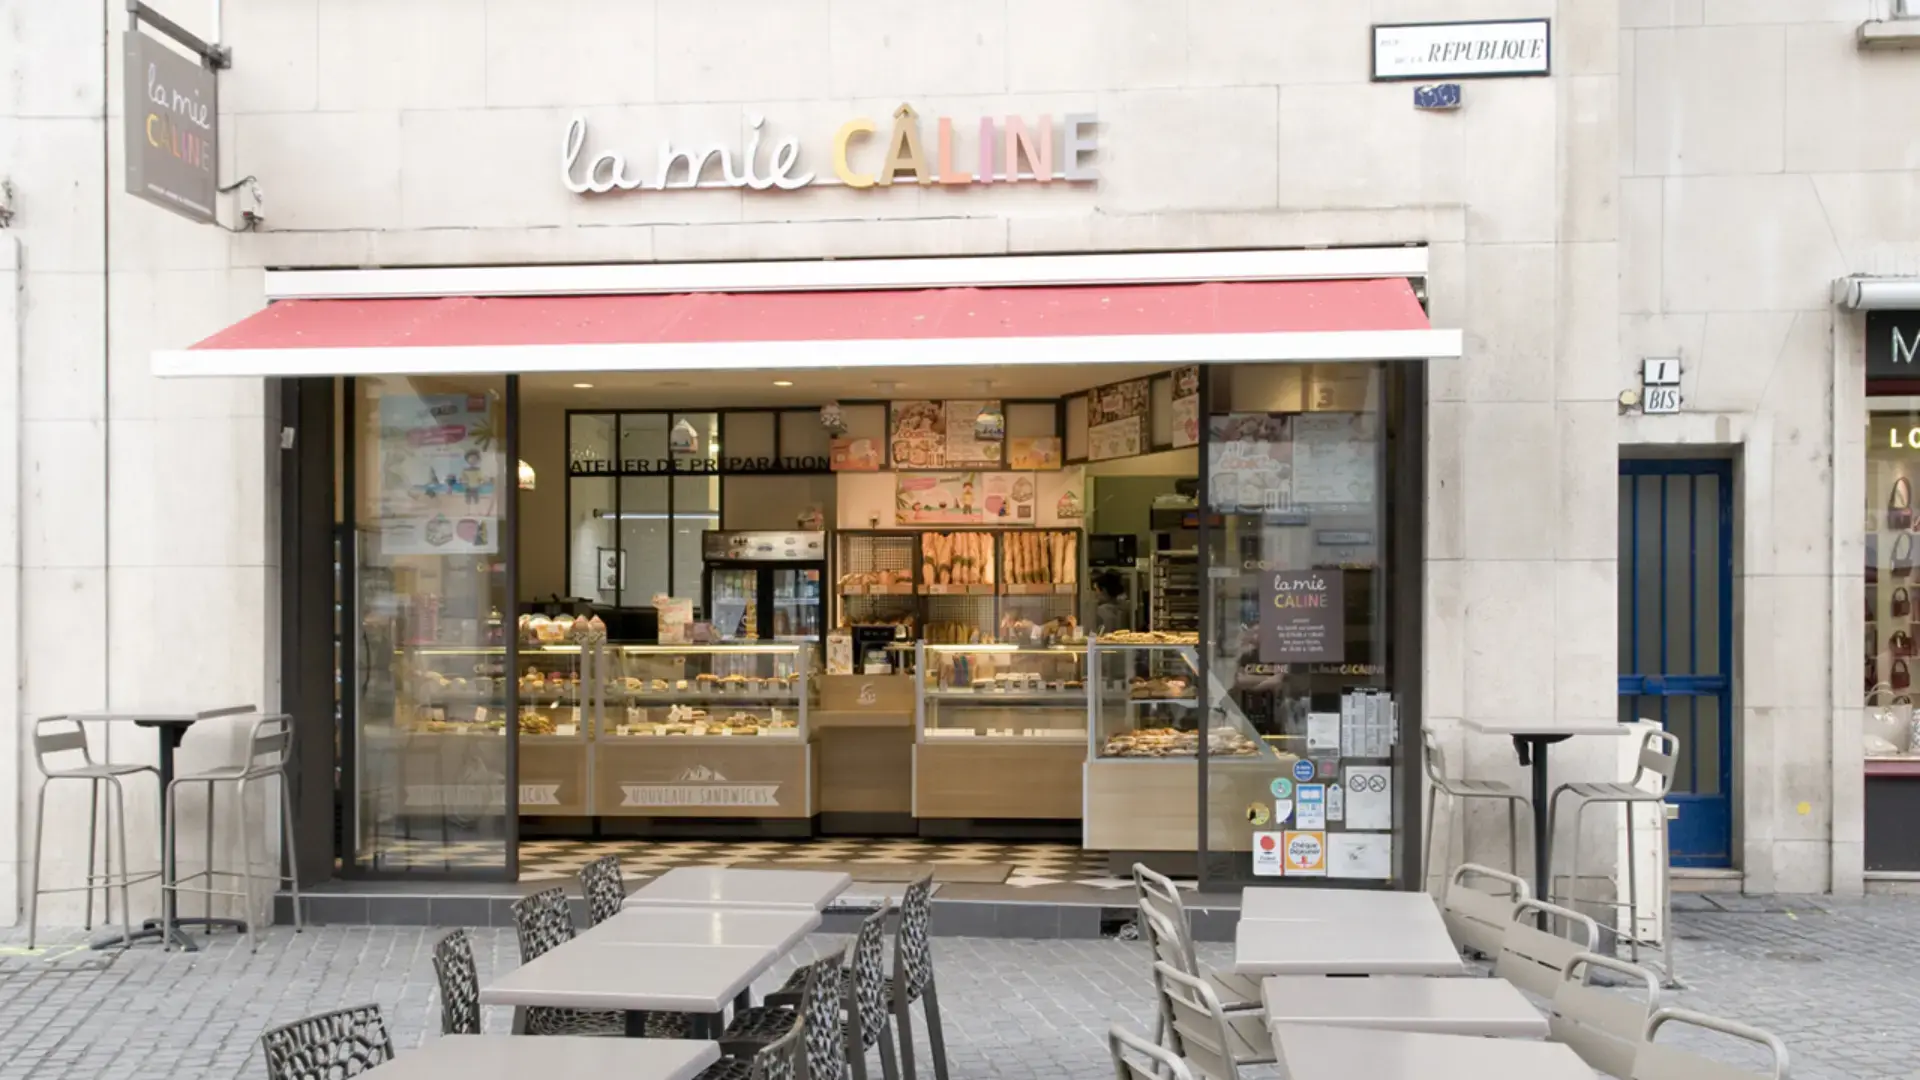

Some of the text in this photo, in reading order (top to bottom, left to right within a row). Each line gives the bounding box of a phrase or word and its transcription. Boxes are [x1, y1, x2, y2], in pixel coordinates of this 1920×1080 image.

[148, 62, 211, 131] la mie
[560, 101, 1101, 195] la mie CÂLINE
[1648, 390, 1677, 409] BIS
[570, 459, 651, 473] ATELIER
[656, 459, 683, 472] DE
[1274, 573, 1327, 591] la mie
